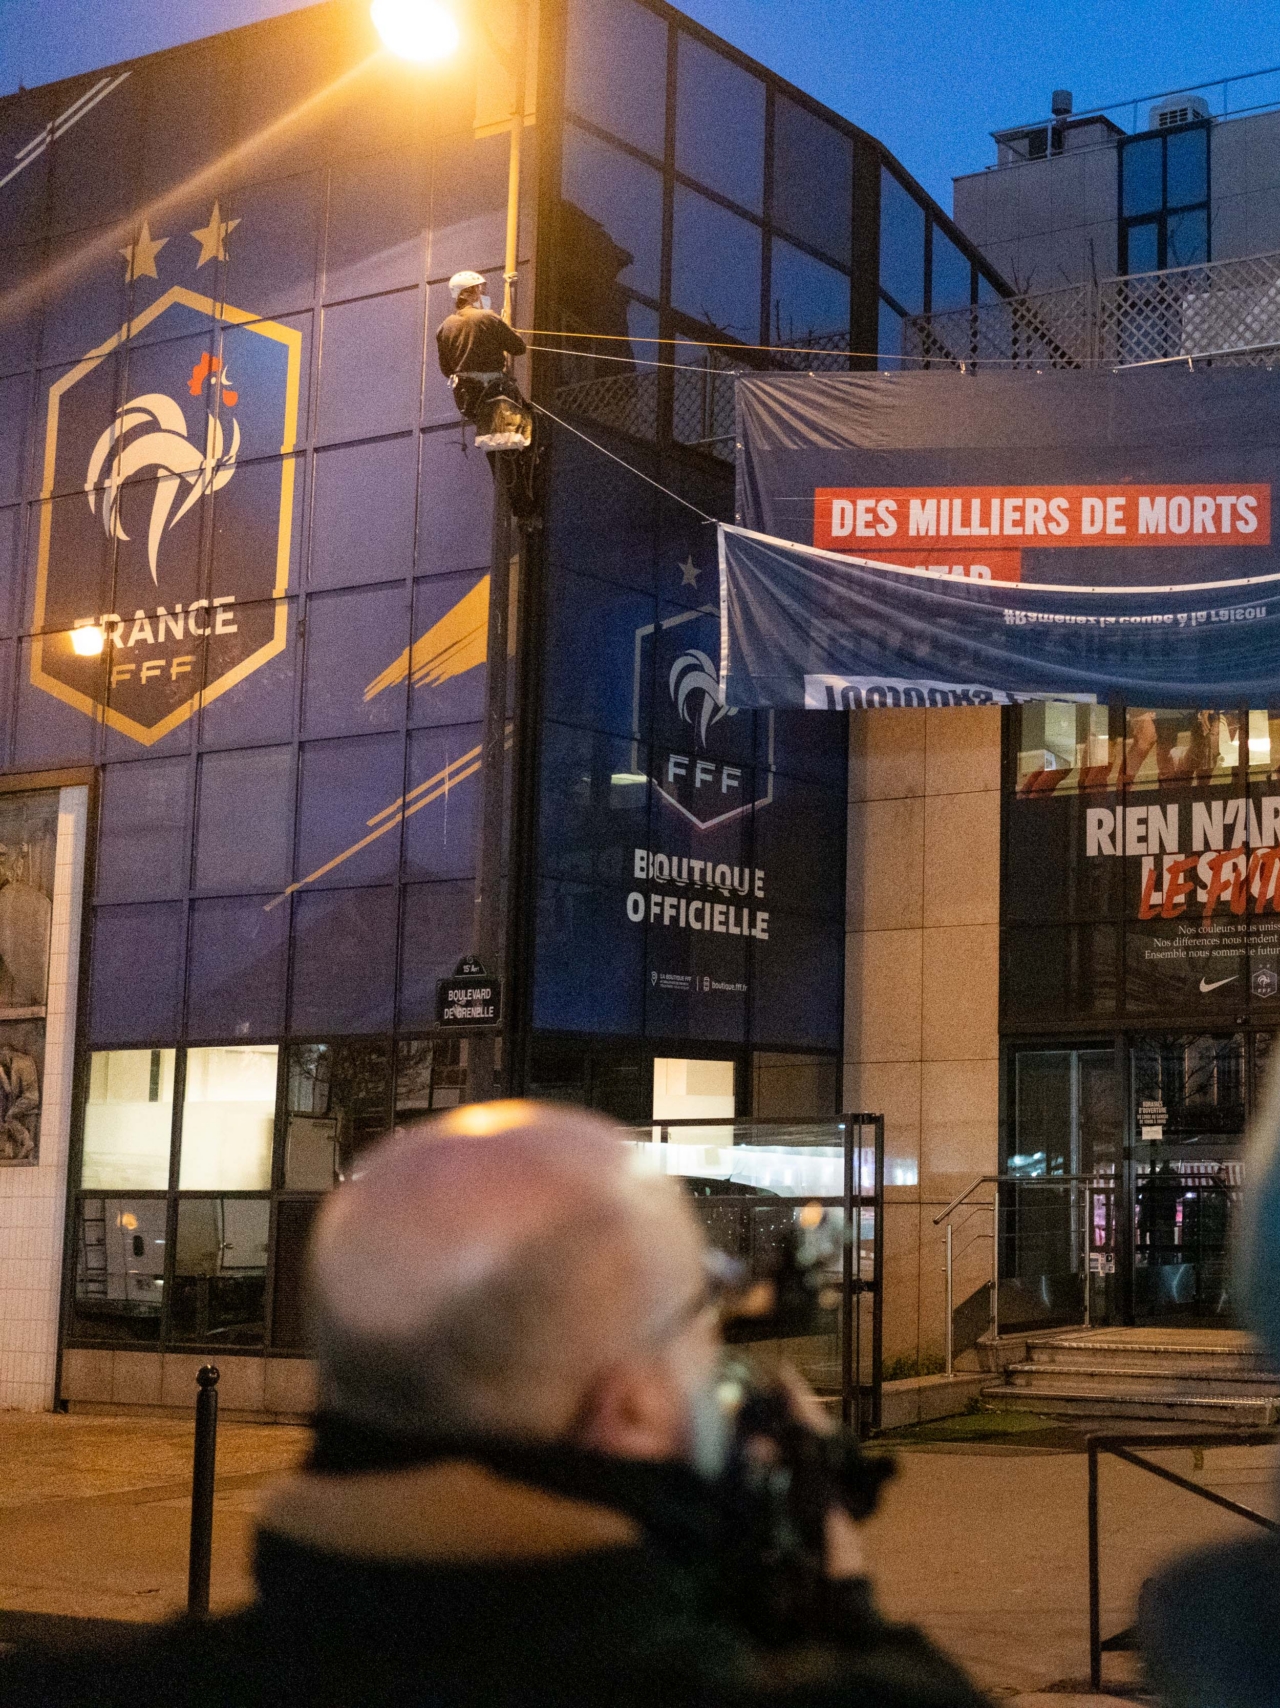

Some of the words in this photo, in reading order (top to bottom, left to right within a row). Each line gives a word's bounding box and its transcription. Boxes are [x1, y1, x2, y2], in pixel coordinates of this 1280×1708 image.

[832, 498, 898, 537] DES
[908, 497, 1069, 536] MILLIERS
[1081, 497, 1127, 535] DE
[1138, 495, 1258, 534] MORTS
[74, 595, 238, 650] RANCE
[110, 655, 196, 689] FFF
[668, 753, 742, 794] FFF
[1086, 803, 1179, 857] RIEN
[634, 848, 765, 898] BOUTIQUE
[626, 891, 769, 940] OFFICIELLE
[1178, 924, 1197, 935] Nos
[1198, 923, 1236, 934] couleurs
[1145, 948, 1187, 960] Ensemble
[1188, 950, 1210, 958] nous
[1257, 945, 1280, 956] futur
[1153, 937, 1171, 948] Nos
[448, 988, 492, 1001] BOULEVARD
[444, 1008, 454, 1020] DE
